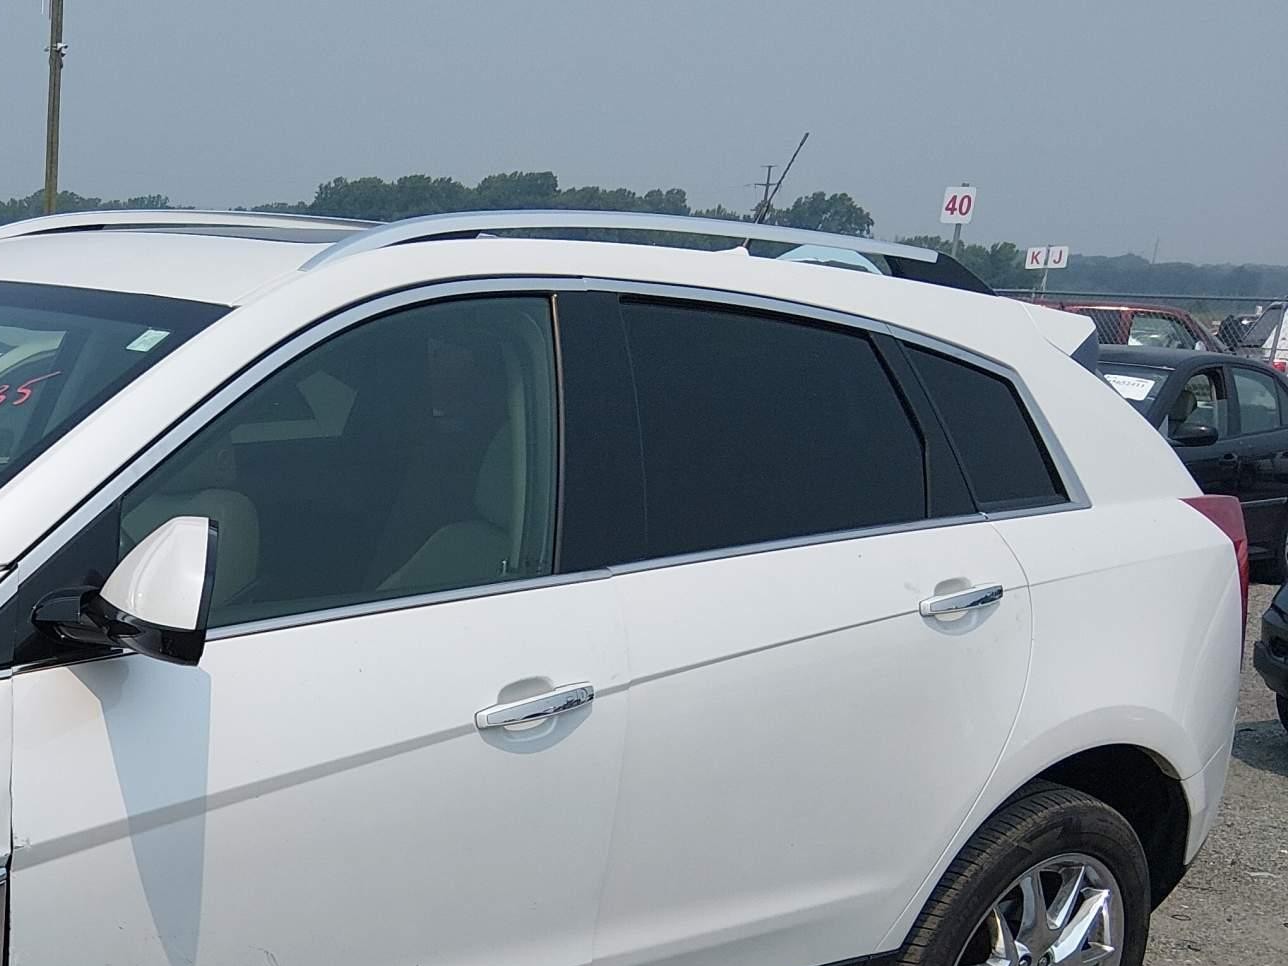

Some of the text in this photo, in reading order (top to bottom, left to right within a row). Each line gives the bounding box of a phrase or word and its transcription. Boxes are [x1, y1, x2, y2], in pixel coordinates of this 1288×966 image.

[945, 194, 972, 216] 40
[1030, 249, 1063, 265] K J
